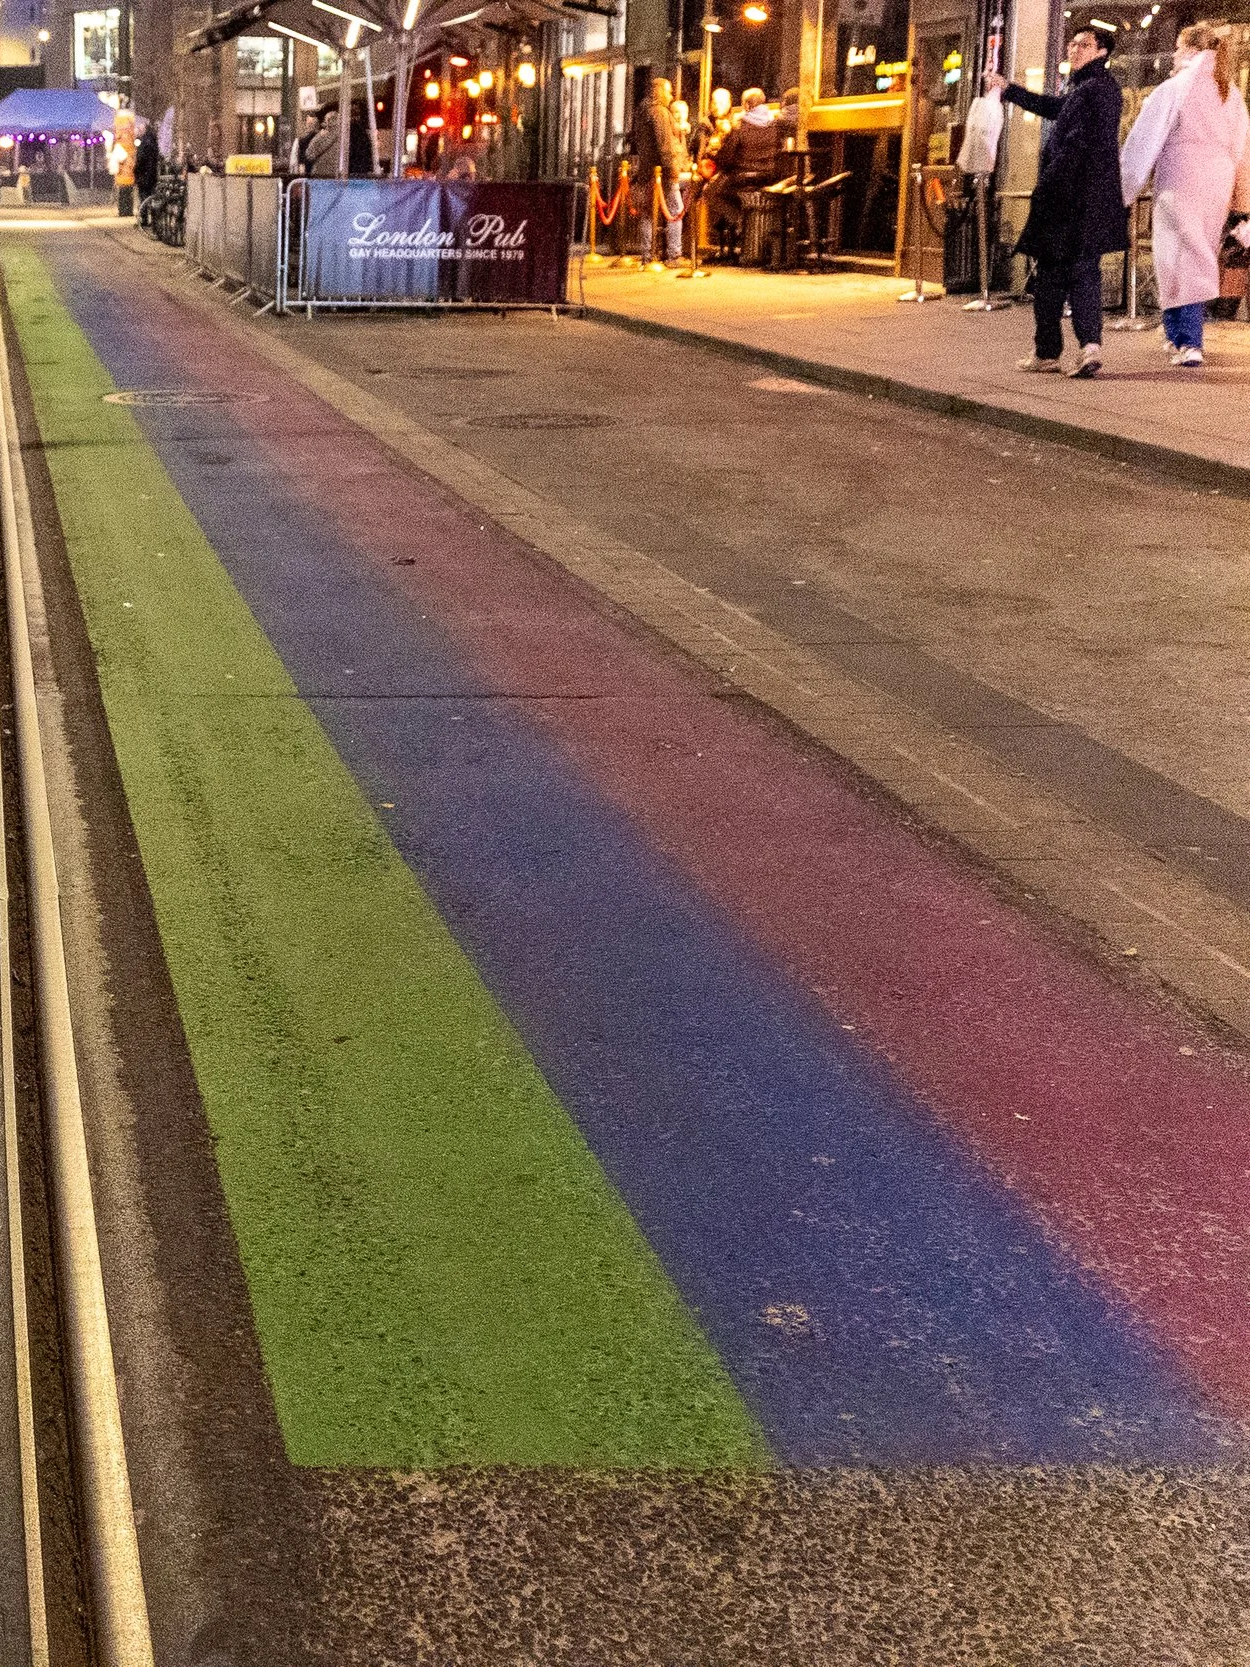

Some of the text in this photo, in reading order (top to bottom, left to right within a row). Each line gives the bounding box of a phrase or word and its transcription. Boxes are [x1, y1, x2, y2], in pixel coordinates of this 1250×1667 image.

[348, 212, 528, 247] London Pub
[350, 248, 524, 260] GAY HEADQUARTERS SINCE 1979
